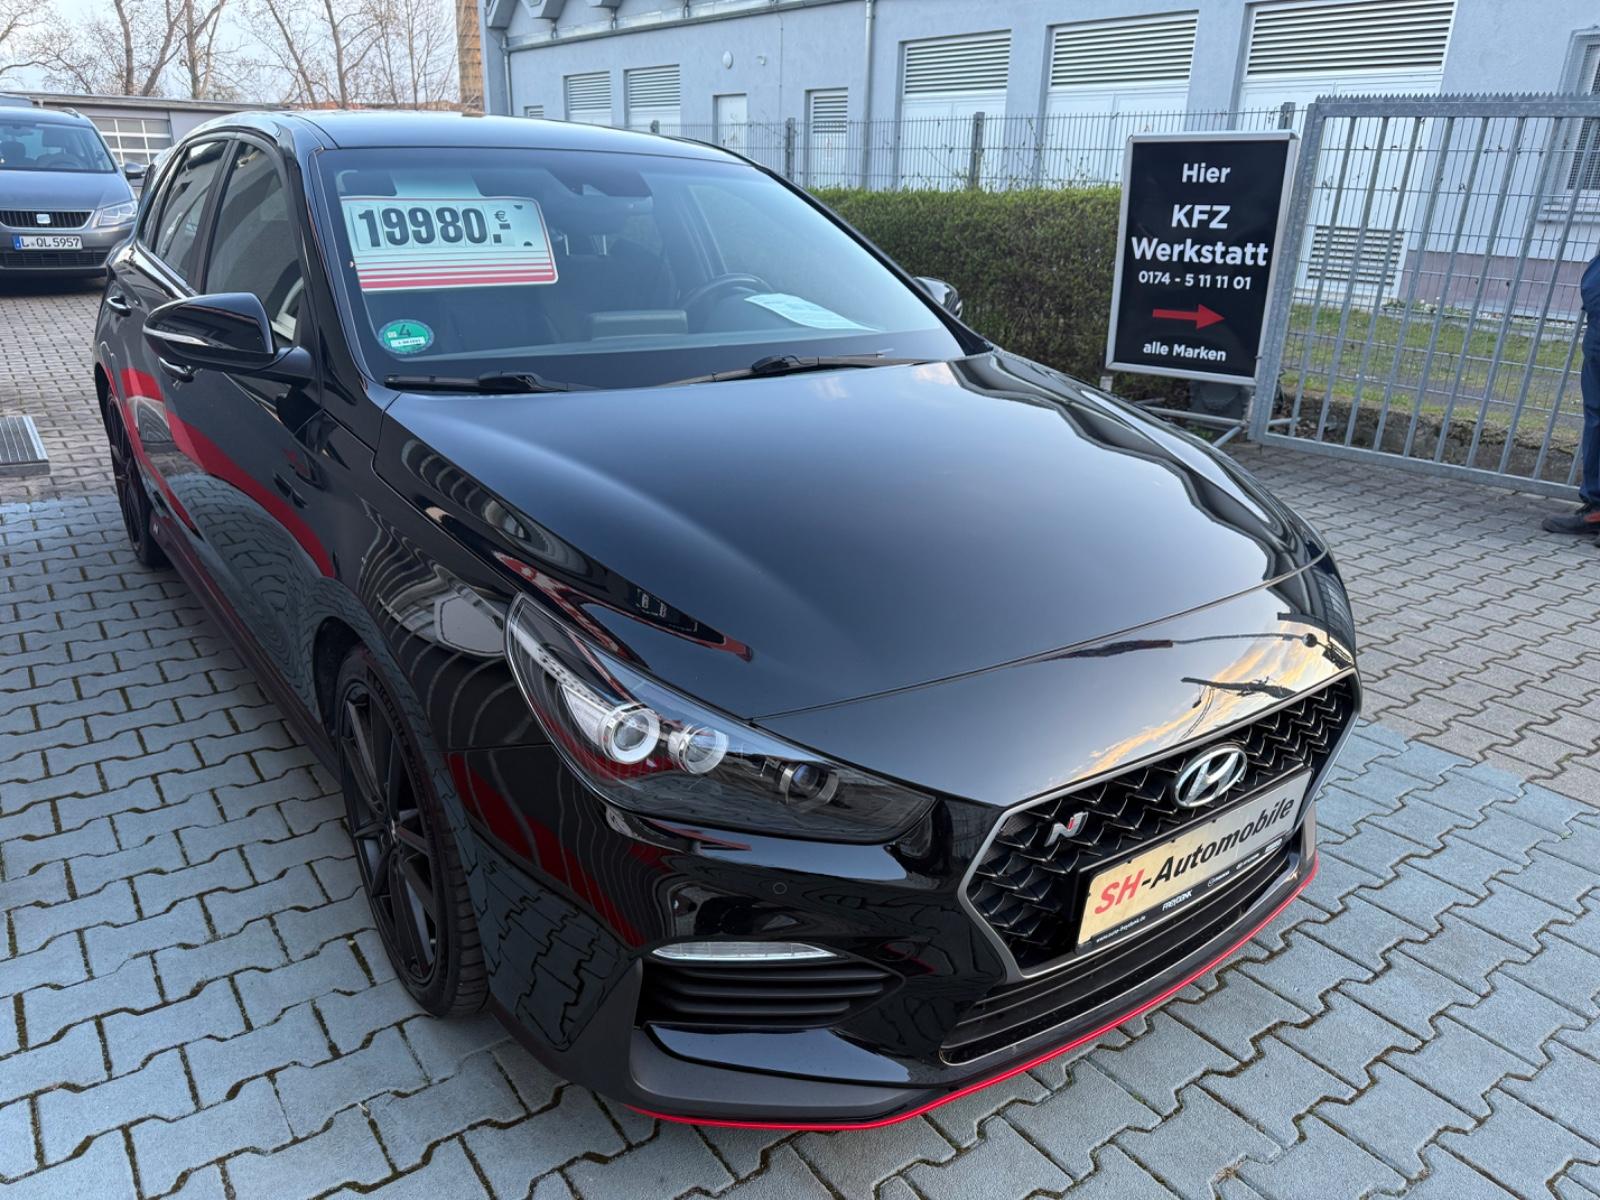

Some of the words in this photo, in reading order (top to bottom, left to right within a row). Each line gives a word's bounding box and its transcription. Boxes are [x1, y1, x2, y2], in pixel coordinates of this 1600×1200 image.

[1181, 162, 1231, 183] Hier
[1171, 204, 1231, 229] KFZ
[1131, 236, 1269, 266] Werkstatt
[1138, 270, 1171, 285] 0174
[1184, 274, 1195, 287] 5
[1199, 275, 1211, 288] 11
[1216, 275, 1228, 289] 11
[1233, 276, 1251, 290] 01
[399, 324, 411, 337] 4
[1143, 341, 1169, 355] alle
[1172, 343, 1227, 362] Marken
[1094, 798, 1295, 915] SH-Automobile
